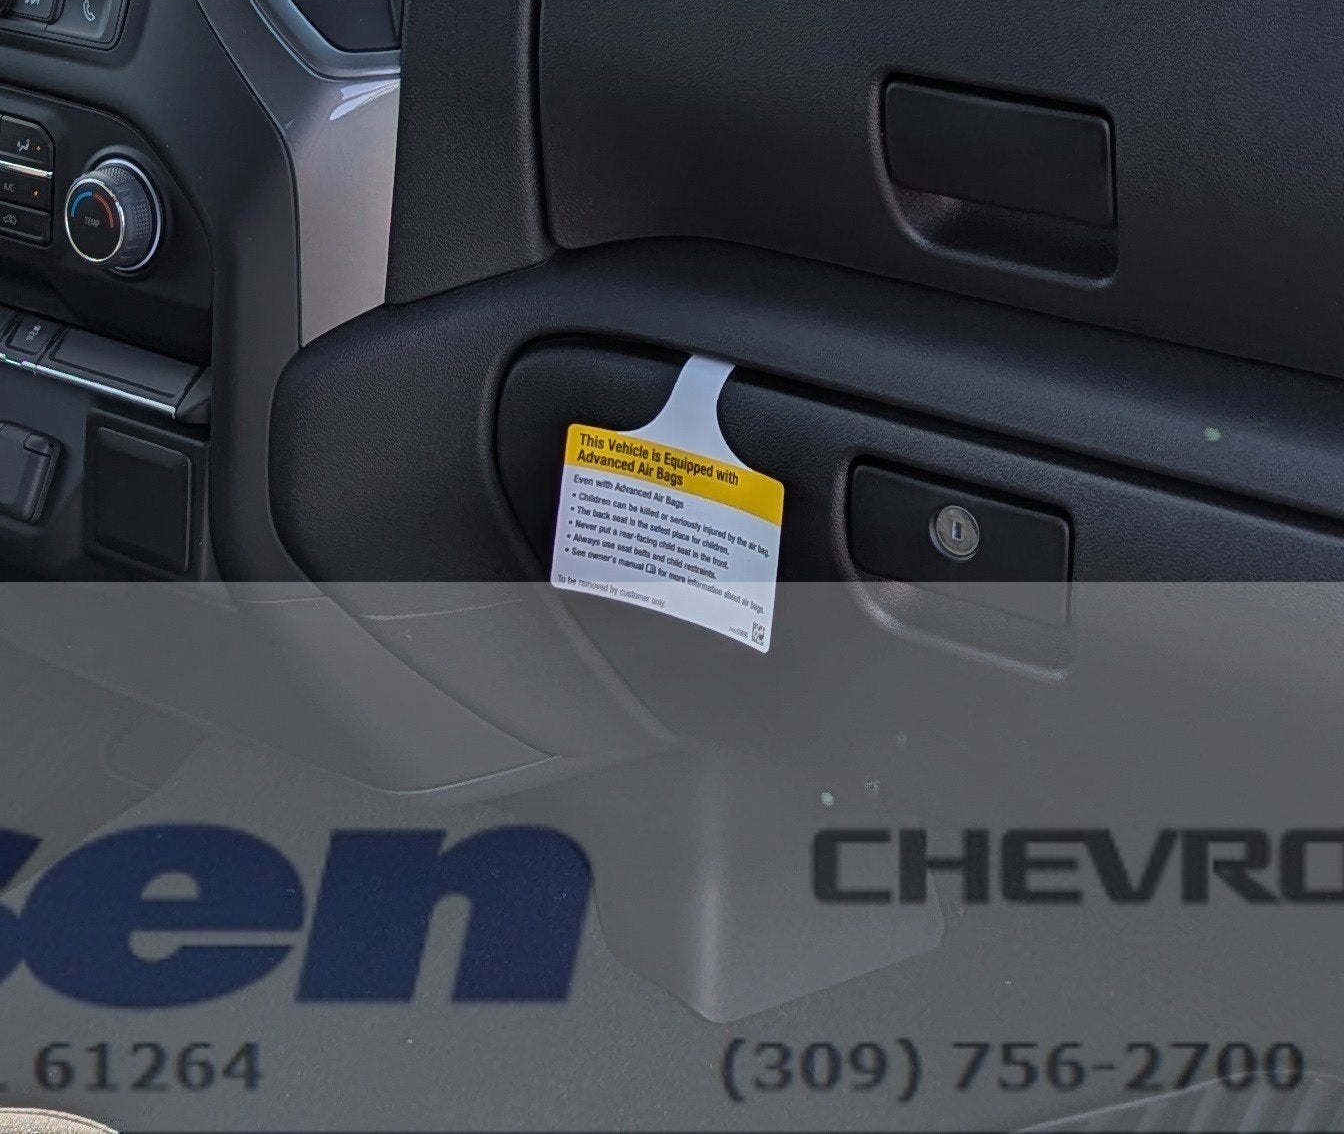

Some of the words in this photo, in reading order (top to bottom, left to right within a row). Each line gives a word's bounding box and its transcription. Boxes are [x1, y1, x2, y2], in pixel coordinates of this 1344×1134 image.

[84, 216, 101, 228] TEMP
[577, 449, 635, 472] Advanced
[638, 462, 654, 476] Air
[656, 466, 683, 486] Bags
[580, 433, 604, 449] This
[609, 438, 649, 459] Vehicle
[664, 452, 713, 477] Equipped
[716, 469, 739, 486] with
[574, 474, 593, 486] Even
[596, 479, 613, 489] with
[615, 483, 652, 499] Advanced
[653, 493, 664, 503] Air
[665, 496, 684, 509] Bags
[575, 519, 597, 531] Never
[599, 526, 611, 534] put
[619, 530, 657, 547] rear-facing
[659, 541, 675, 551] child
[677, 546, 691, 556] seat
[701, 552, 710, 562] the
[578, 506, 590, 516] The
[593, 509, 610, 520] back
[612, 514, 628, 524] seat
[638, 519, 648, 529] the
[650, 524, 670, 535] safest
[672, 530, 690, 541] place
[692, 535, 701, 544] for
[702, 539, 729, 555] children.
[579, 492, 611, 505] Children
[613, 501, 627, 509] can
[629, 503, 638, 512] be
[640, 506, 659, 518] killed
[670, 516, 701, 532] seriously
[703, 524, 727, 539] injured
[728, 532, 736, 544] by
[737, 536, 747, 547] the
[748, 541, 757, 550] air
[573, 533, 600, 546] Always
[602, 540, 615, 549] use
[617, 544, 632, 553] seat
[634, 547, 650, 558] belts
[652, 553, 665, 562] and
[666, 557, 683, 568] child
[558, 574, 566, 583] To
[568, 576, 576, 585] be
[578, 579, 609, 592] removed
[610, 585, 618, 596] by
[619, 589, 650, 602] customer
[571, 547, 586, 557] See
[588, 551, 616, 564] owner's
[618, 559, 644, 570] manual
[658, 567, 667, 577] for
[669, 572, 685, 583] more
[687, 576, 722, 596] information
